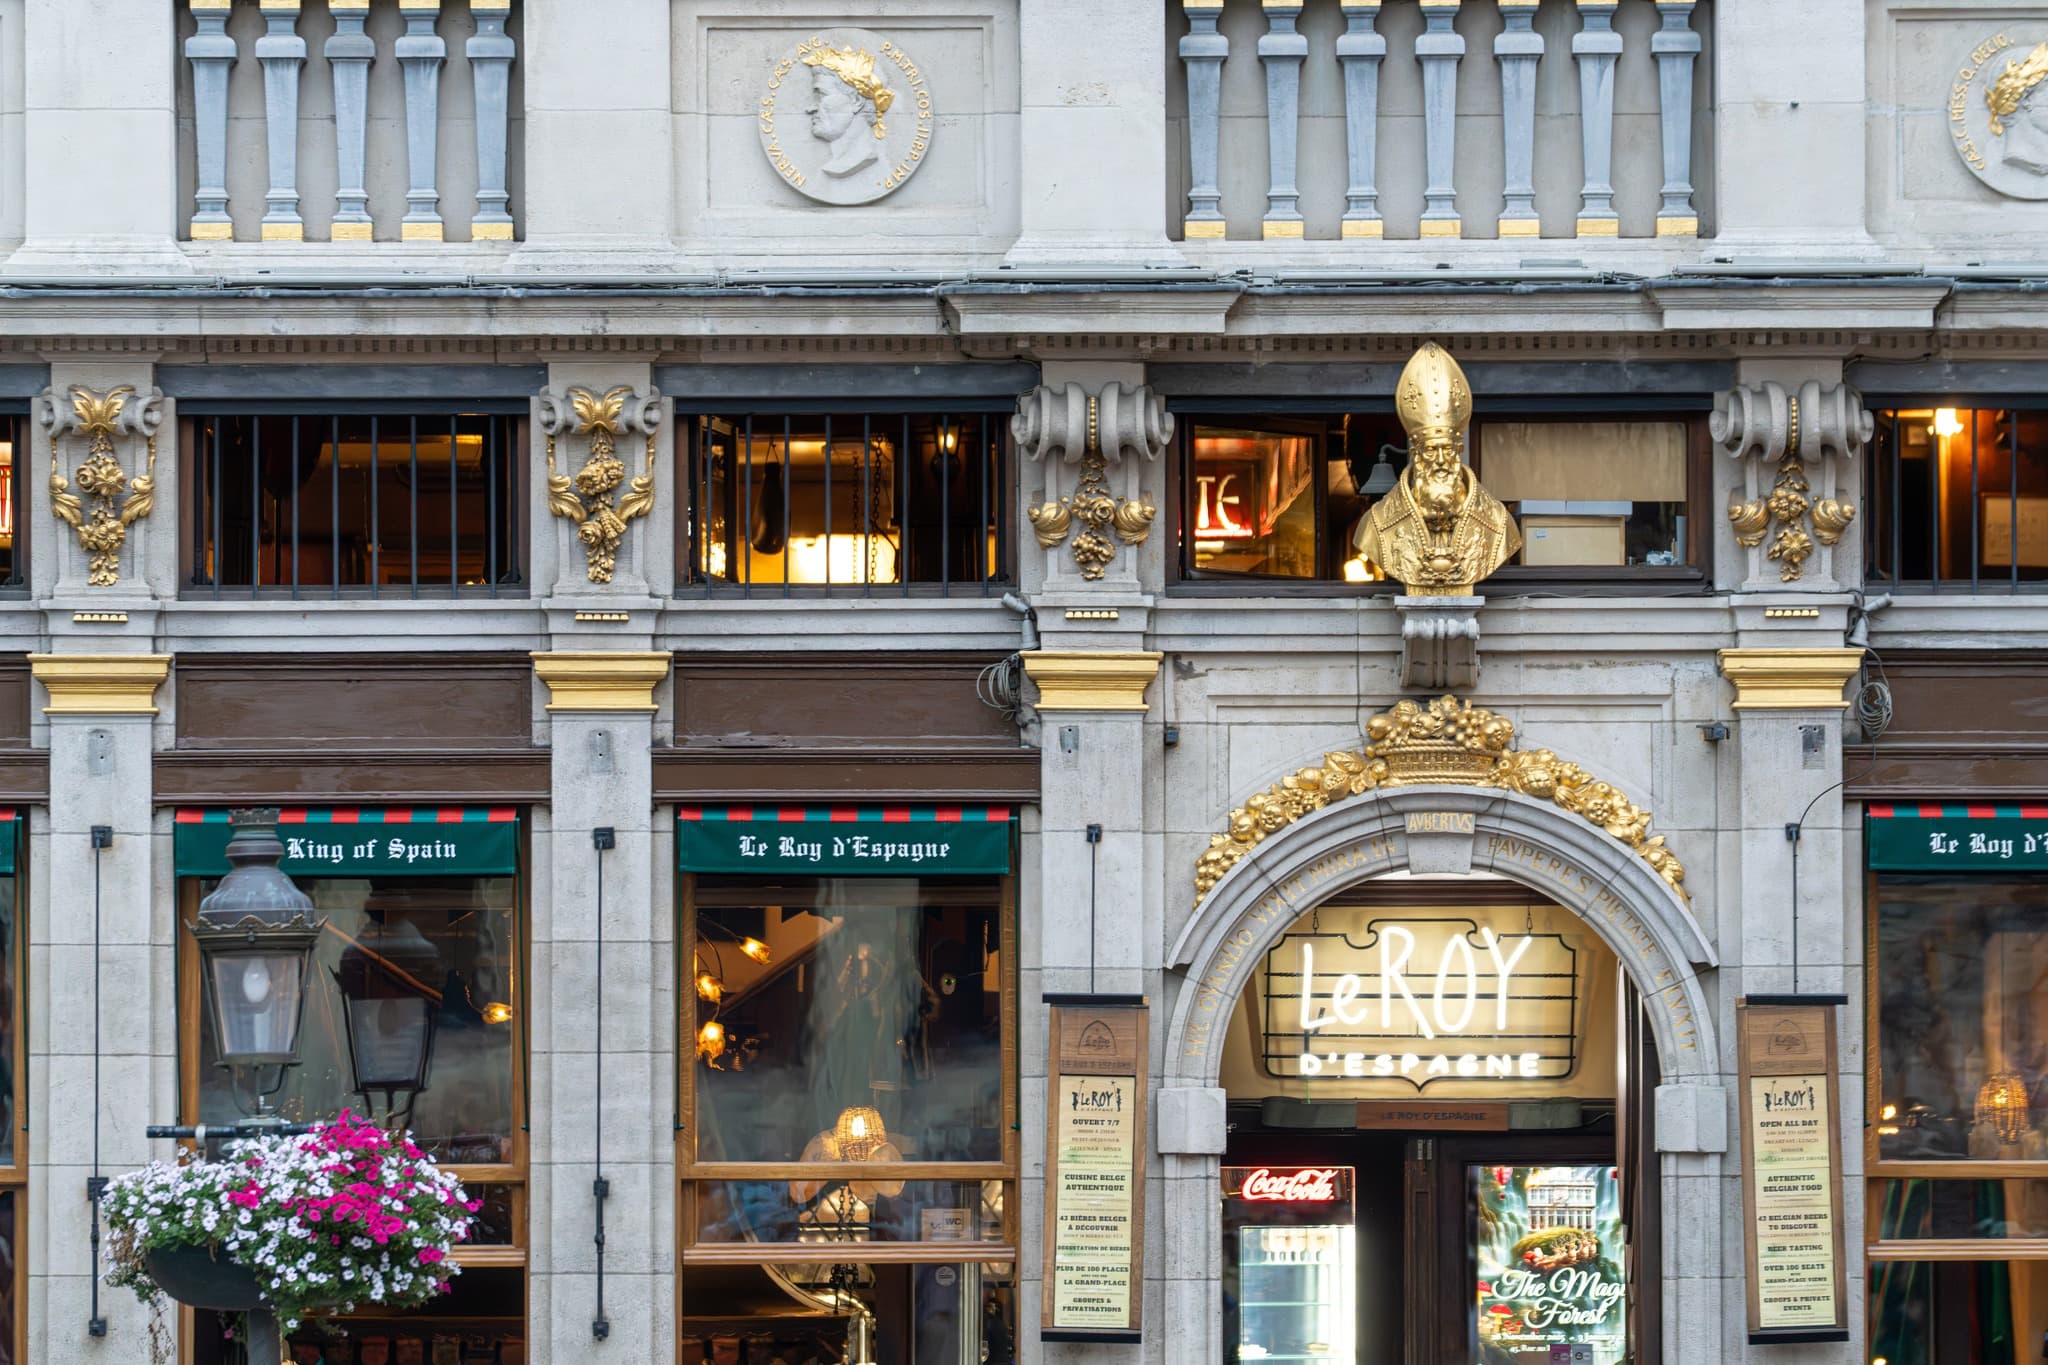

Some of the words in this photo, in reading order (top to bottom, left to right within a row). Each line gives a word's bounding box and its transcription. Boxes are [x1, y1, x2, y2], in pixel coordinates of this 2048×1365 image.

[287, 837, 344, 864] King
[353, 838, 378, 859] of
[388, 838, 456, 863] Spain
[739, 835, 768, 857] Le
[779, 836, 822, 862] Roy
[833, 835, 950, 862] d'Espagne
[1929, 832, 1960, 854] Le
[1969, 832, 2013, 858] Roy
[1300, 1052, 1541, 1077] D'ESPAGNE
[1107, 1119, 1120, 1127] 7/7
[1802, 1119, 1819, 1127] DAY
[1767, 1174, 1816, 1182] AUTHENTIC
[945, 1217, 962, 1226] WC
[1491, 1269, 1547, 1299] The
[1524, 1298, 1609, 1329] Forest
